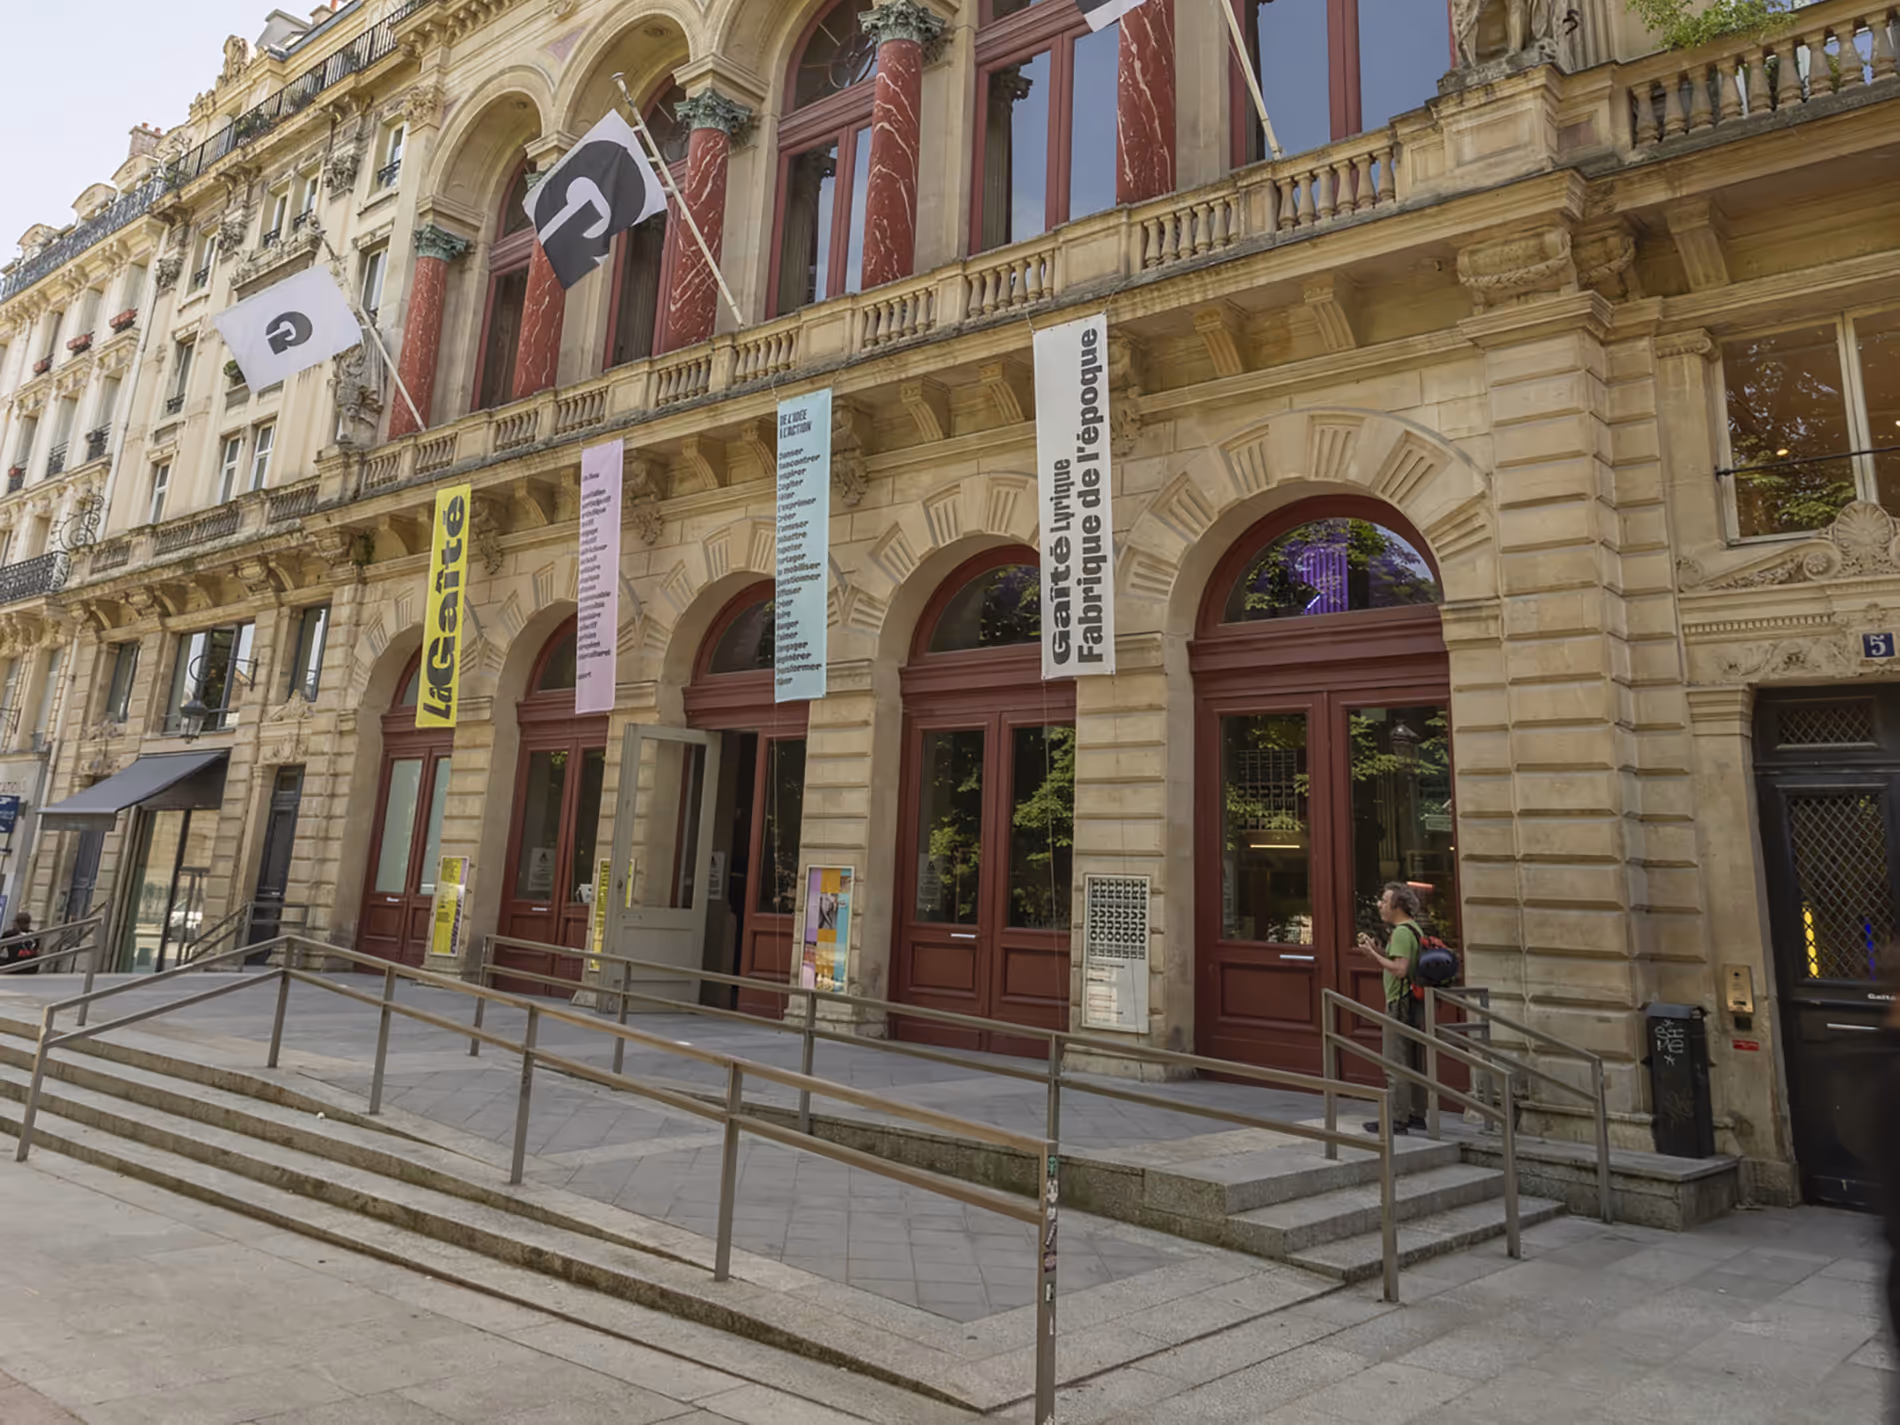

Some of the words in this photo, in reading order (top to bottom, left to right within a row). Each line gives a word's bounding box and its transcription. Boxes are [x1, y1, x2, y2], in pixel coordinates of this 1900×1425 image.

[1076, 328, 1104, 463] l'époque
[1050, 459, 1075, 534] Lyrique
[1077, 468, 1101, 508] de
[1077, 515, 1107, 664] Fabrique
[1870, 635, 1886, 656] 5
[1090, 879, 1098, 941] OUVERT
[1098, 880, 1106, 942] OUVERT
[1106, 880, 1114, 942] OUVERT
[1114, 880, 1123, 942] OUVERT
[1122, 880, 1131, 943] OUVERT
[1130, 881, 1139, 943] OUVERT
[1138, 881, 1147, 944] OUVERT
